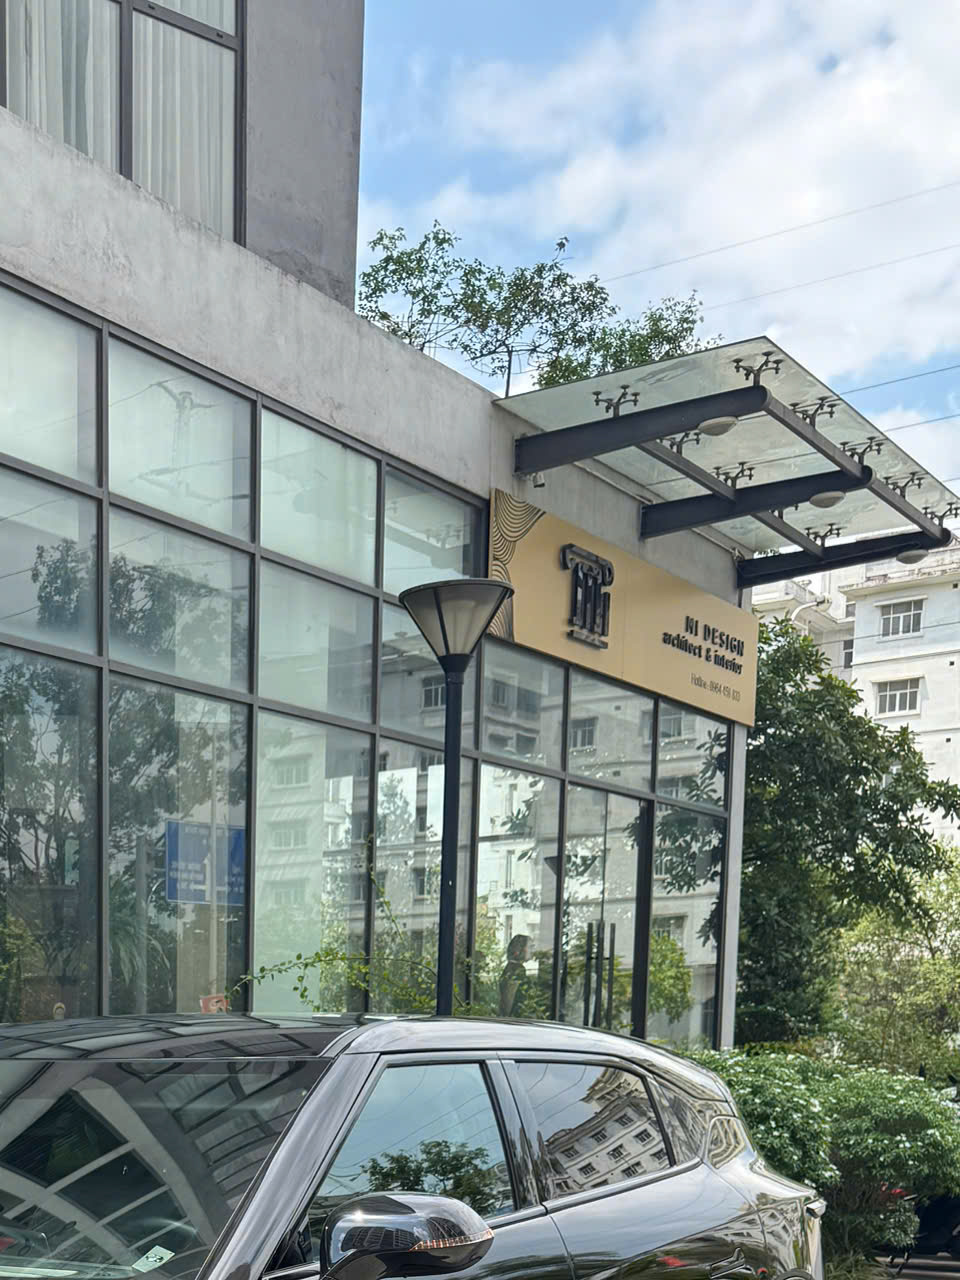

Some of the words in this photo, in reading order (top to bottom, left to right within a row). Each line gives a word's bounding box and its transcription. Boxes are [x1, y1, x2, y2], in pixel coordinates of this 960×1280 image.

[662, 632, 703, 658] architect
[705, 647, 713, 662] &
[714, 650, 743, 675] interior
[703, 624, 745, 657] DESIGN
